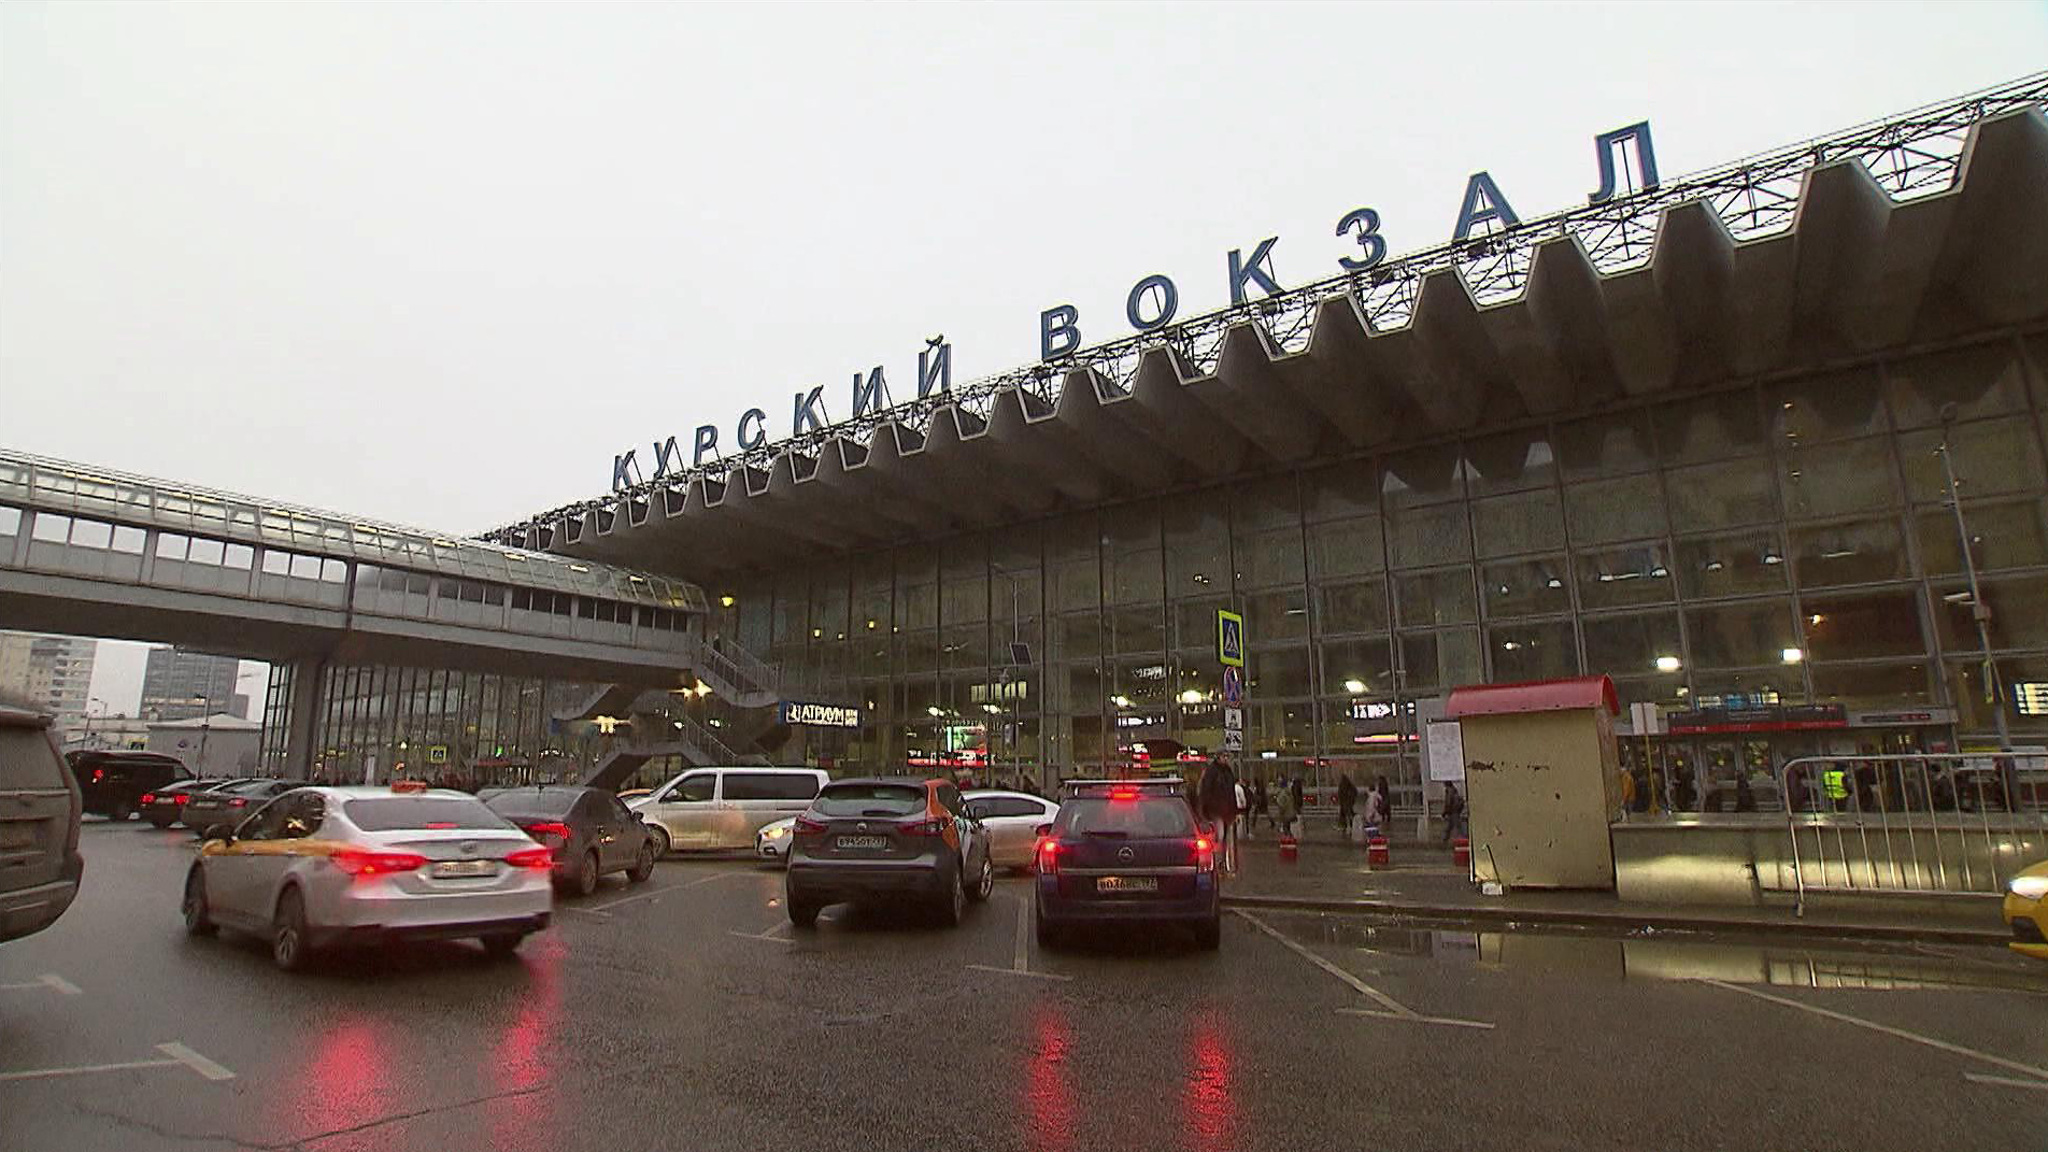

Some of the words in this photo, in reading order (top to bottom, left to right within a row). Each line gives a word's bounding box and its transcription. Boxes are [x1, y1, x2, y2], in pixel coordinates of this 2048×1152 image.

[613, 334, 952, 492] КУРСКИЙ
[1041, 119, 1661, 362] ВОКЗАЛ
[801, 704, 844, 723] АТРИУМ
